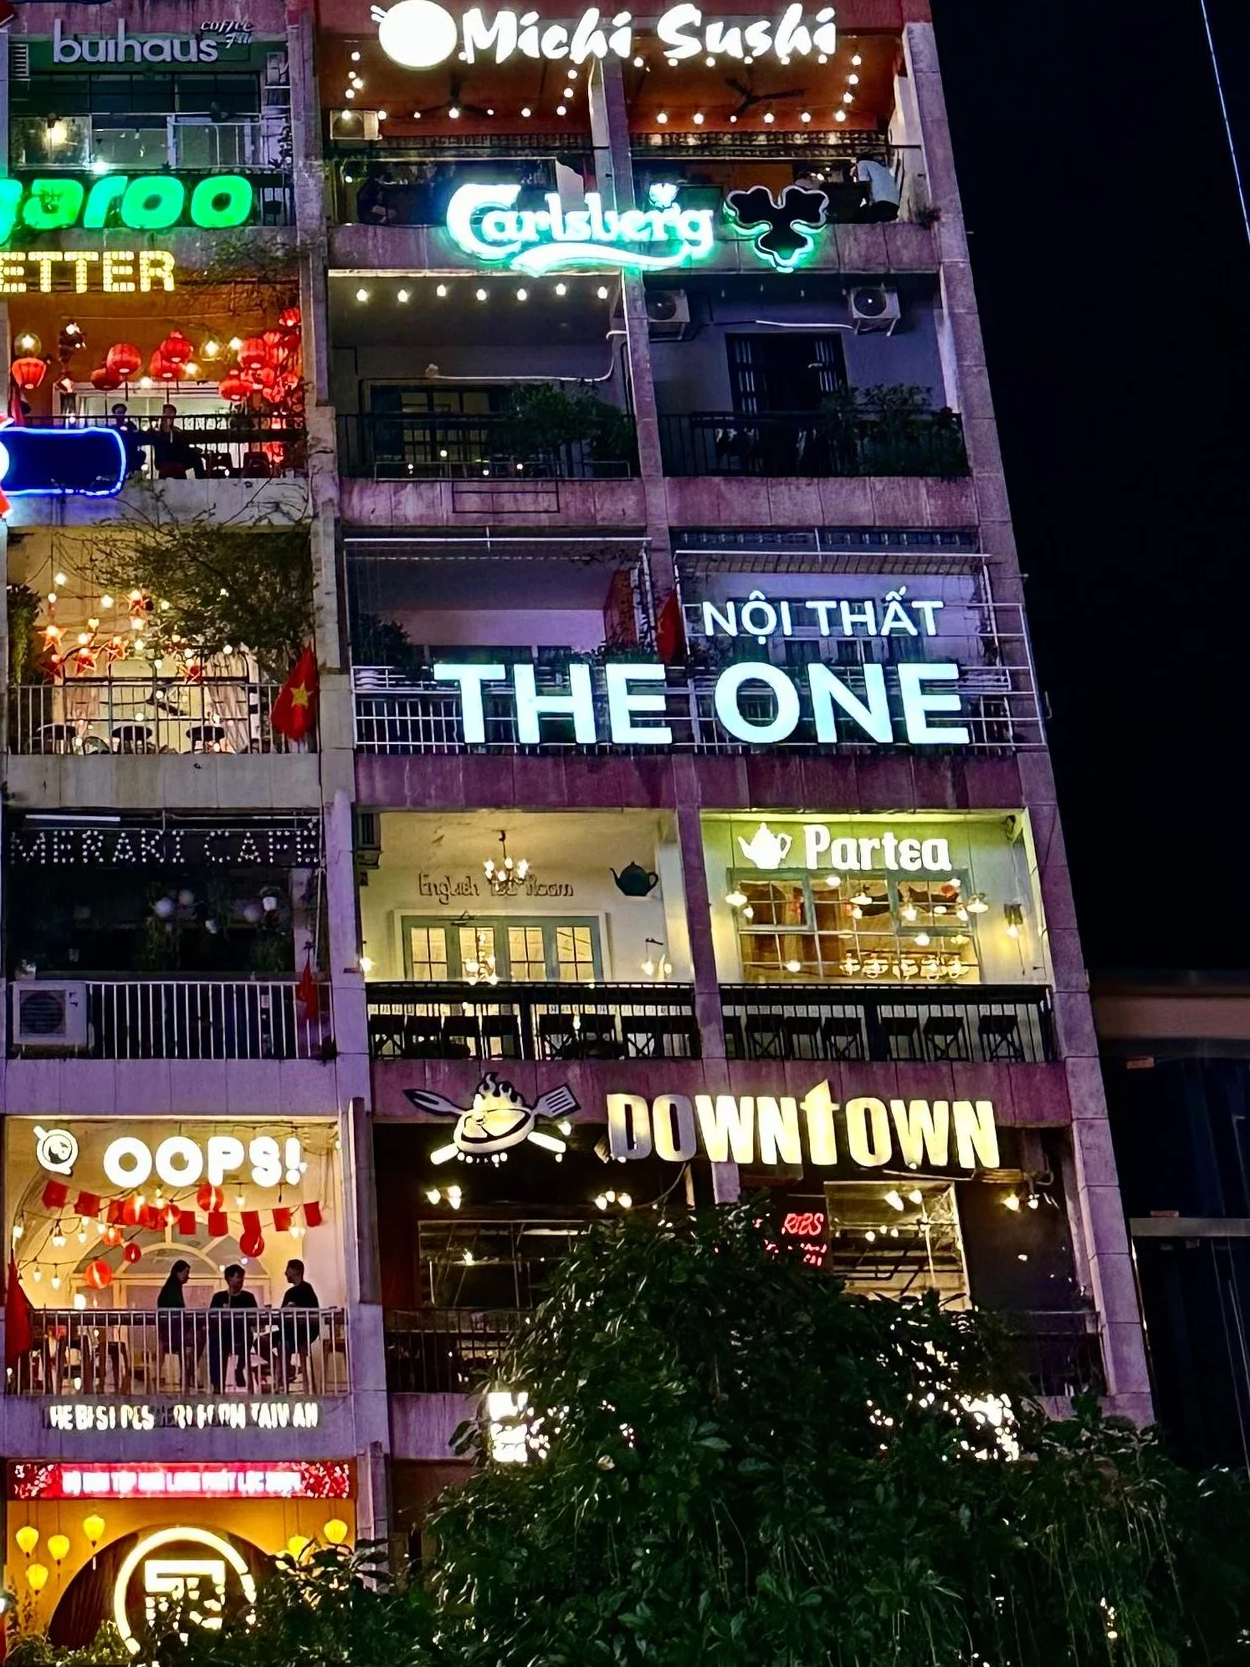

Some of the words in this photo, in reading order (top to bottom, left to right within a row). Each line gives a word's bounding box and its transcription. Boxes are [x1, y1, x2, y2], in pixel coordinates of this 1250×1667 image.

[461, 5, 633, 64] Michi
[657, 3, 836, 61] Sushi
[446, 183, 715, 271] Carlsberg
[702, 589, 791, 646] NỘI
[805, 586, 945, 637] THẤT
[434, 661, 673, 746] THE
[713, 661, 971, 746] ONE
[9, 828, 186, 865] MERAKI
[205, 817, 319, 863] CAFÉ
[803, 823, 952, 872] Partea
[418, 871, 480, 906] English
[103, 1135, 302, 1188] OOPS!
